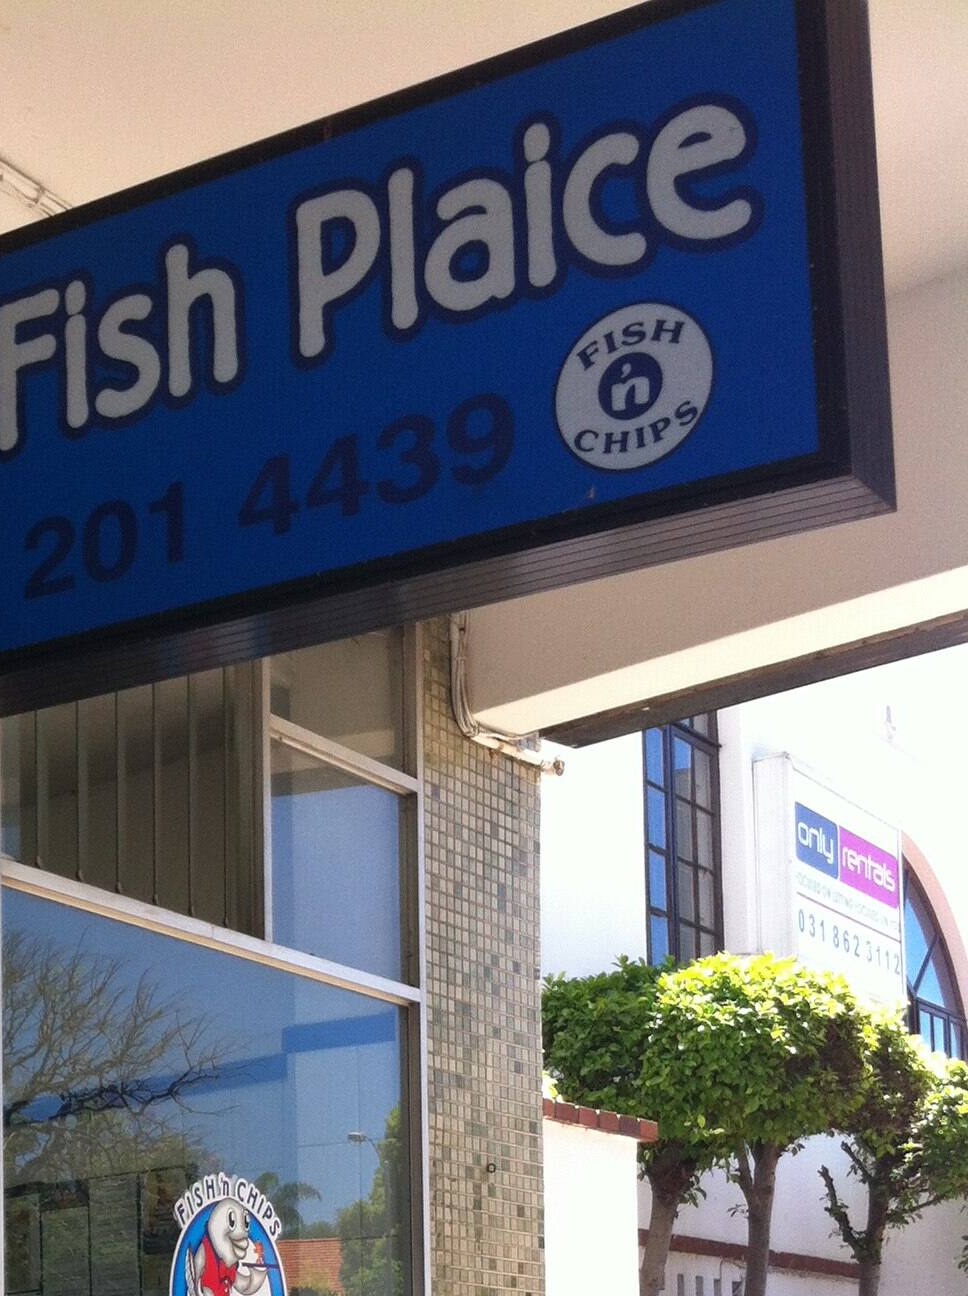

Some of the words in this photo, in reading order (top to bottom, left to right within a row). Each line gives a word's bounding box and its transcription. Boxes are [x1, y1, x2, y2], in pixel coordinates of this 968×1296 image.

[293, 105, 754, 359] Plaice
[576, 319, 686, 371] FISH
[573, 400, 699, 454] CHIPS
[24, 481, 188, 599] 201
[238, 393, 515, 535] 4439
[797, 822, 834, 864] only
[841, 846, 896, 892] rentals
[798, 909, 825, 942] 031
[833, 925, 860, 958] 862
[866, 941, 900, 975] 3112
[177, 1178, 216, 1226] FISH
[236, 1180, 281, 1237] CHIPS
